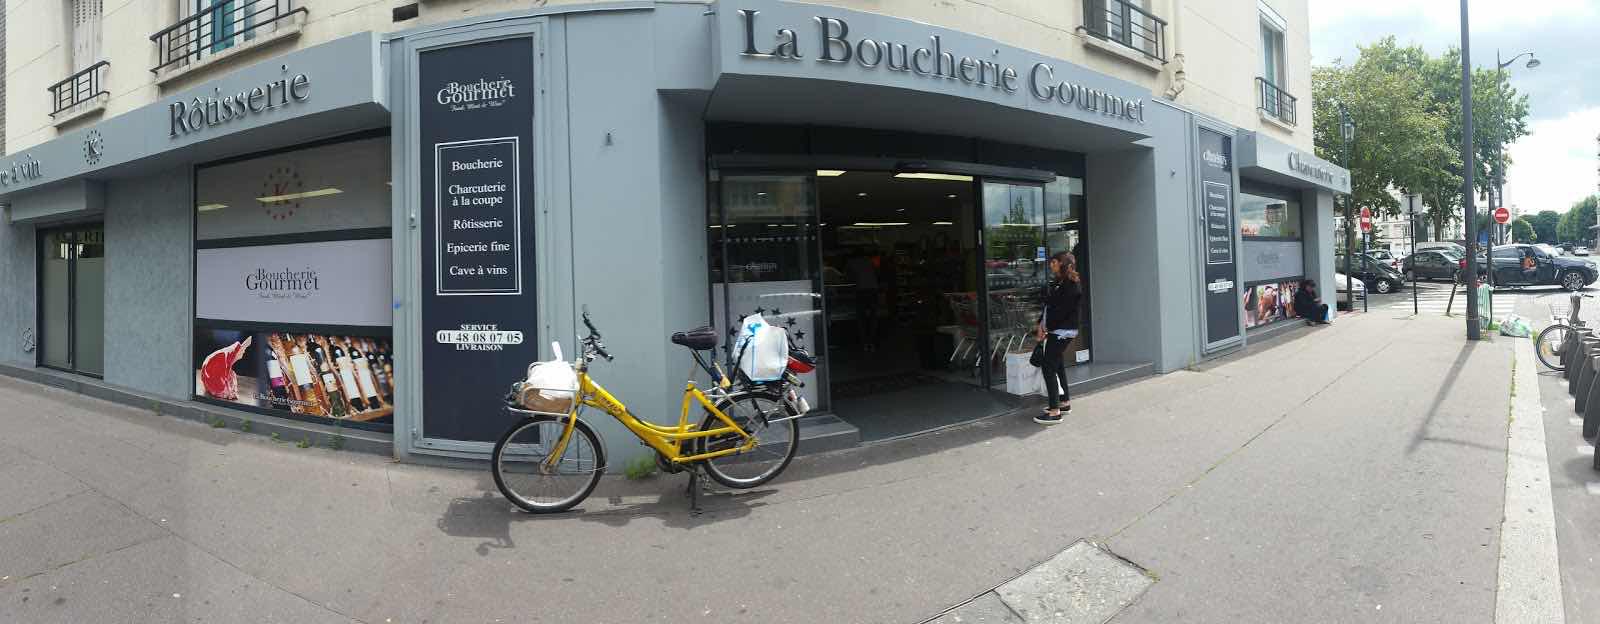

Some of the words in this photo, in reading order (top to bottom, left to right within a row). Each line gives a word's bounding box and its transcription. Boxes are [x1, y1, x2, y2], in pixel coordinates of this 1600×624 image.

[737, 8, 803, 61] La
[813, 15, 1018, 94] Boucherie
[1029, 61, 1147, 124] Gourmet
[447, 76, 511, 95] Boucherie
[168, 64, 312, 138] Rôtisserie
[437, 83, 516, 105] Gourmet
[452, 157, 503, 171] Boucherie
[448, 181, 506, 195] Charcuterie
[452, 197, 458, 206] à
[461, 196, 470, 206] la
[472, 195, 503, 207] coupe
[453, 217, 503, 230] Rôtisserie
[447, 242, 488, 255] Epicerie
[491, 241, 510, 252] fine
[256, 266, 317, 281] Boucherie
[449, 265, 475, 276] Cave
[477, 265, 484, 275] à
[486, 264, 508, 275] vins
[246, 274, 320, 291] Gourmet
[439, 332, 452, 342] 01
[455, 333, 469, 343] 48
[473, 333, 486, 343] 08
[489, 333, 503, 343] 07
[507, 333, 520, 343] 05
[456, 343, 503, 351] LIVRAISON
